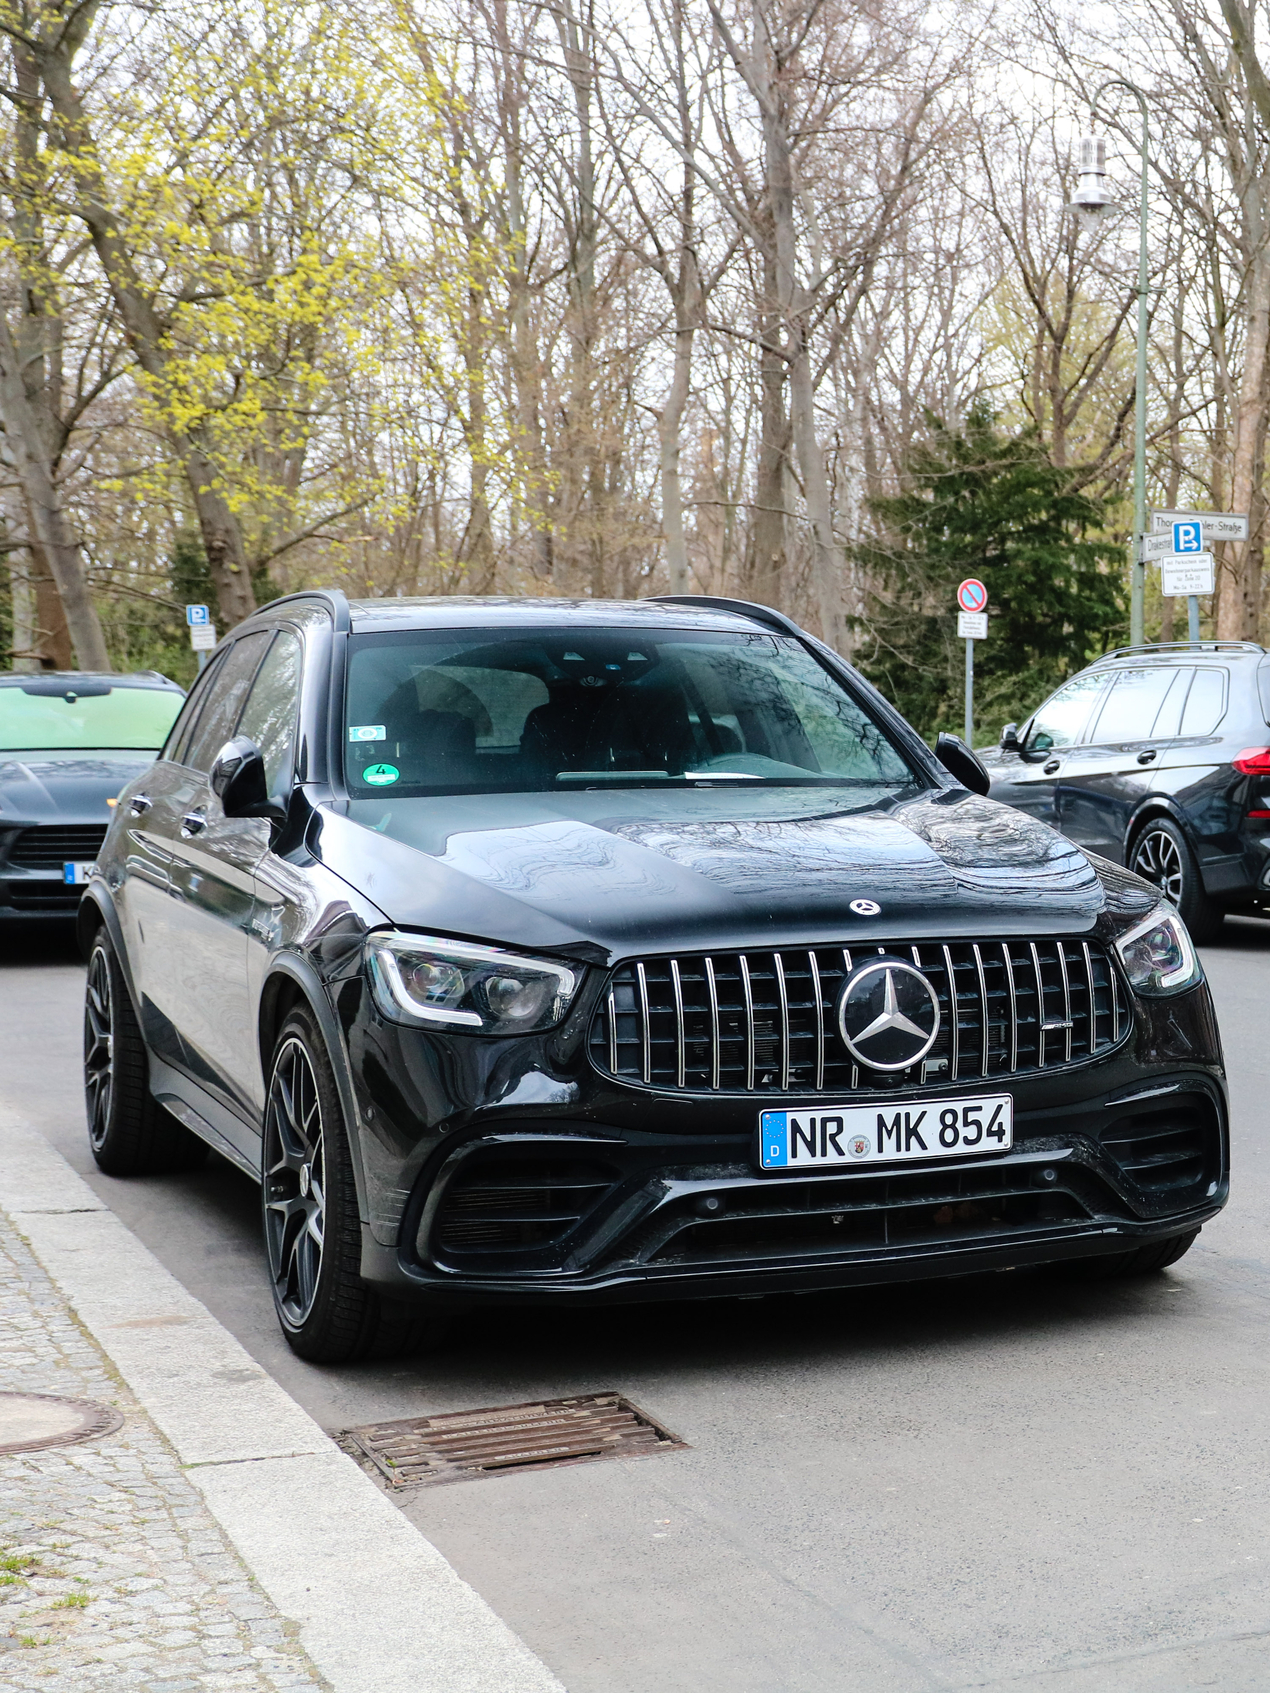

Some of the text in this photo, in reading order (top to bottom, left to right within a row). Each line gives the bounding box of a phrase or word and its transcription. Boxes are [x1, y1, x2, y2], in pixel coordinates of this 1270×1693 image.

[376, 765, 386, 774] 4
[790, 1116, 846, 1159] NR
[877, 1110, 928, 1154] MK
[938, 1103, 1006, 1149] 854
[770, 1145, 780, 1157] D
